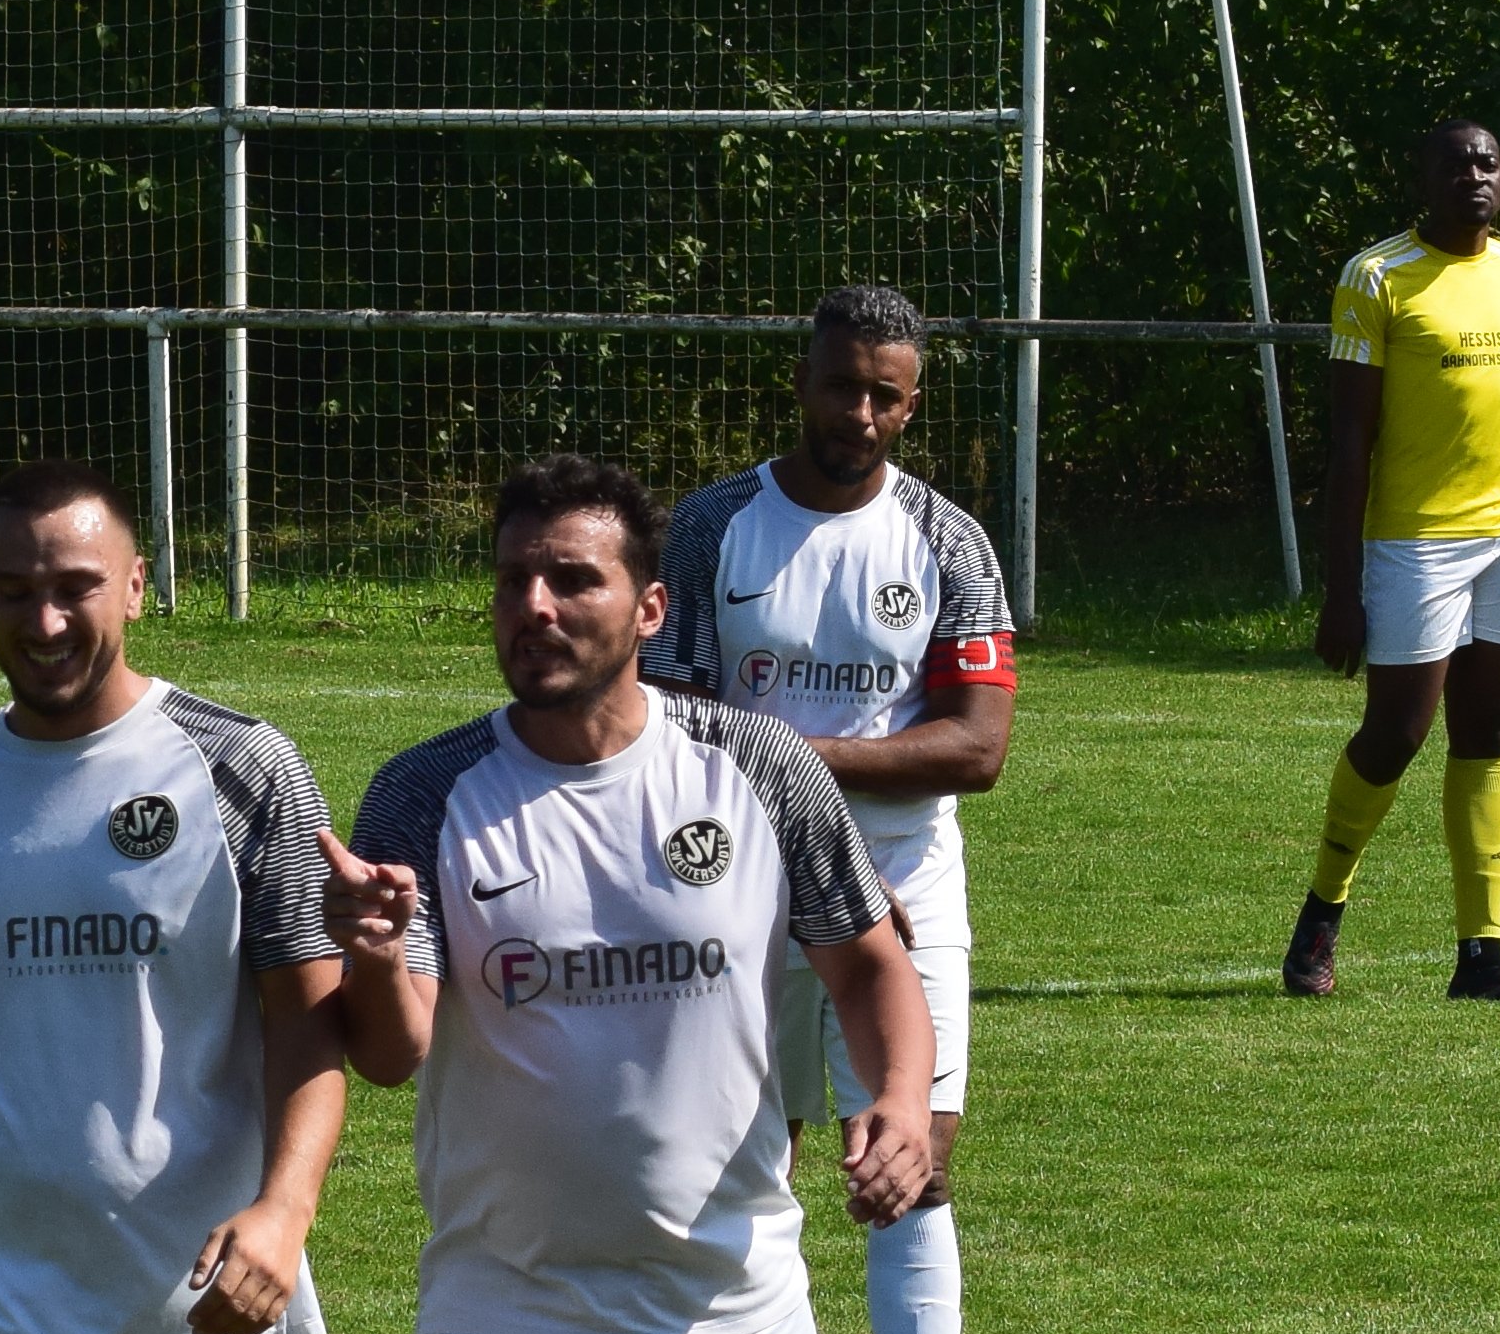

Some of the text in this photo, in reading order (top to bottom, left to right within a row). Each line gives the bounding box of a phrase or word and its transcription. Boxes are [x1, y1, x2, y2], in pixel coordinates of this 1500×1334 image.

[886, 587, 911, 615] SV
[113, 819, 173, 855] WEITERSTADT
[128, 799, 165, 837] SV
[670, 843, 730, 881] WEITERSTADT
[681, 825, 717, 864] SV
